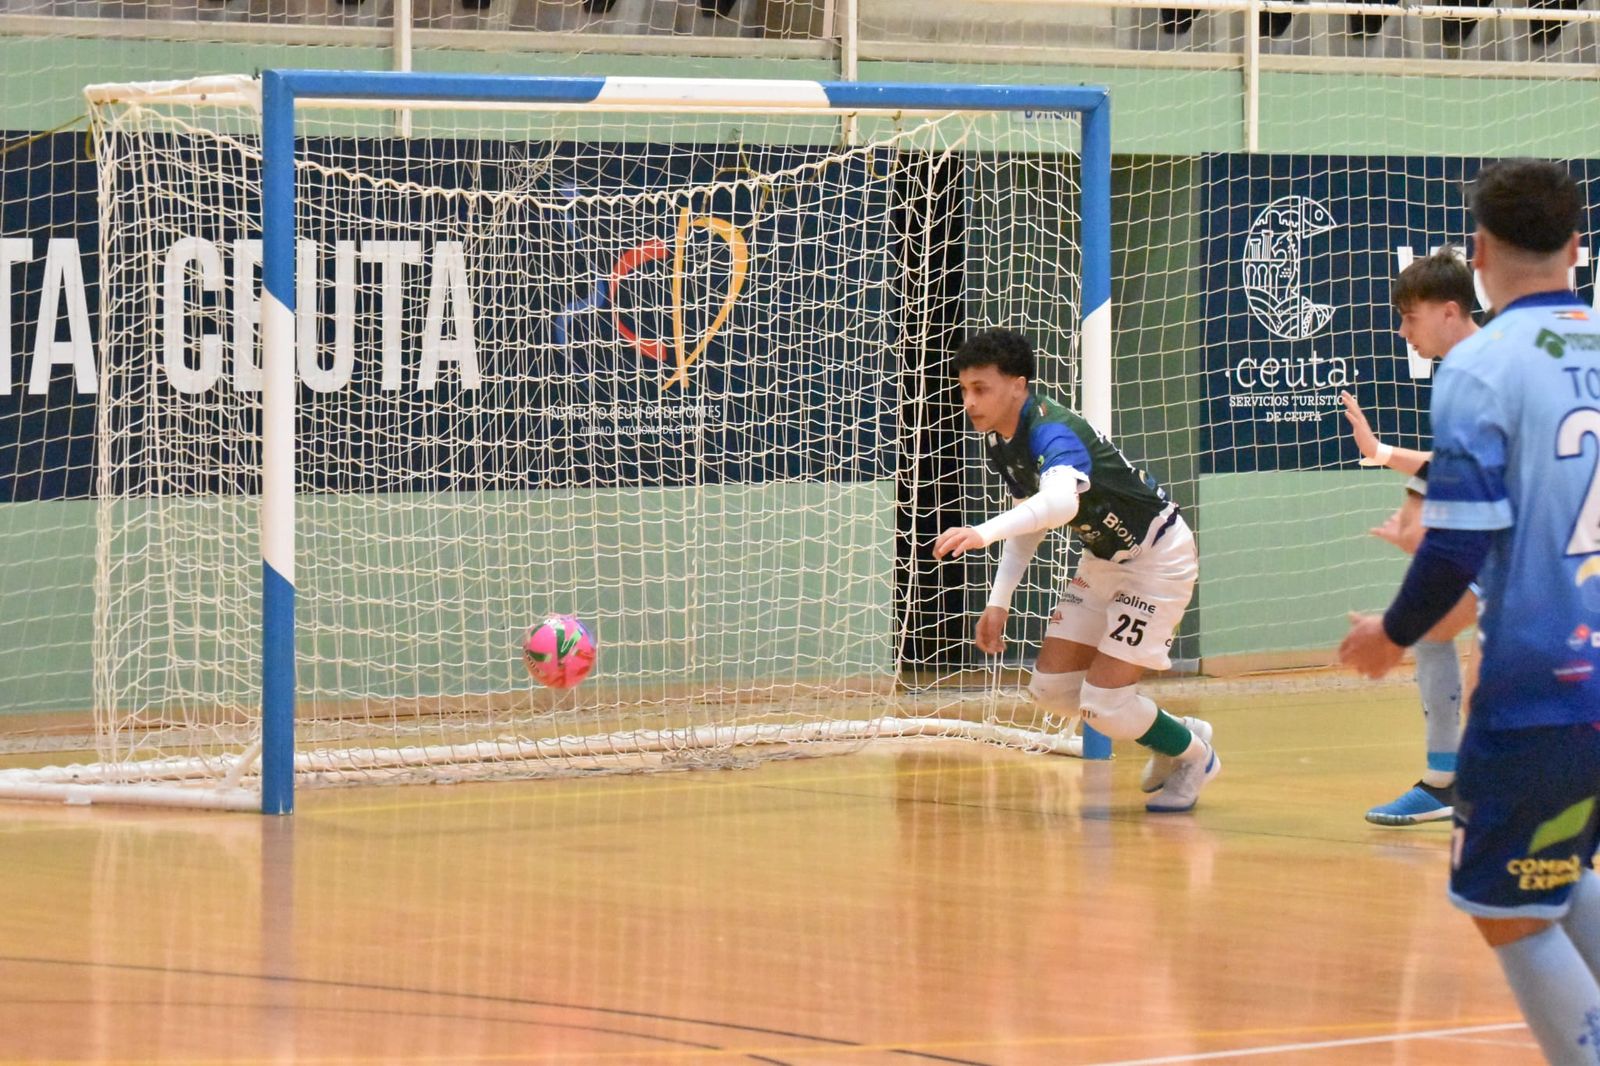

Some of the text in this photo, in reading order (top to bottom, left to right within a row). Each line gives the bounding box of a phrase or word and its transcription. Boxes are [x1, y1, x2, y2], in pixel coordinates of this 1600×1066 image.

[163, 237, 481, 394] CEUTA
[1229, 392, 1357, 407] SERVICIOS TURÍSTICS
[1266, 411, 1322, 422] DE CEUTA
[1109, 613, 1147, 647] 25
